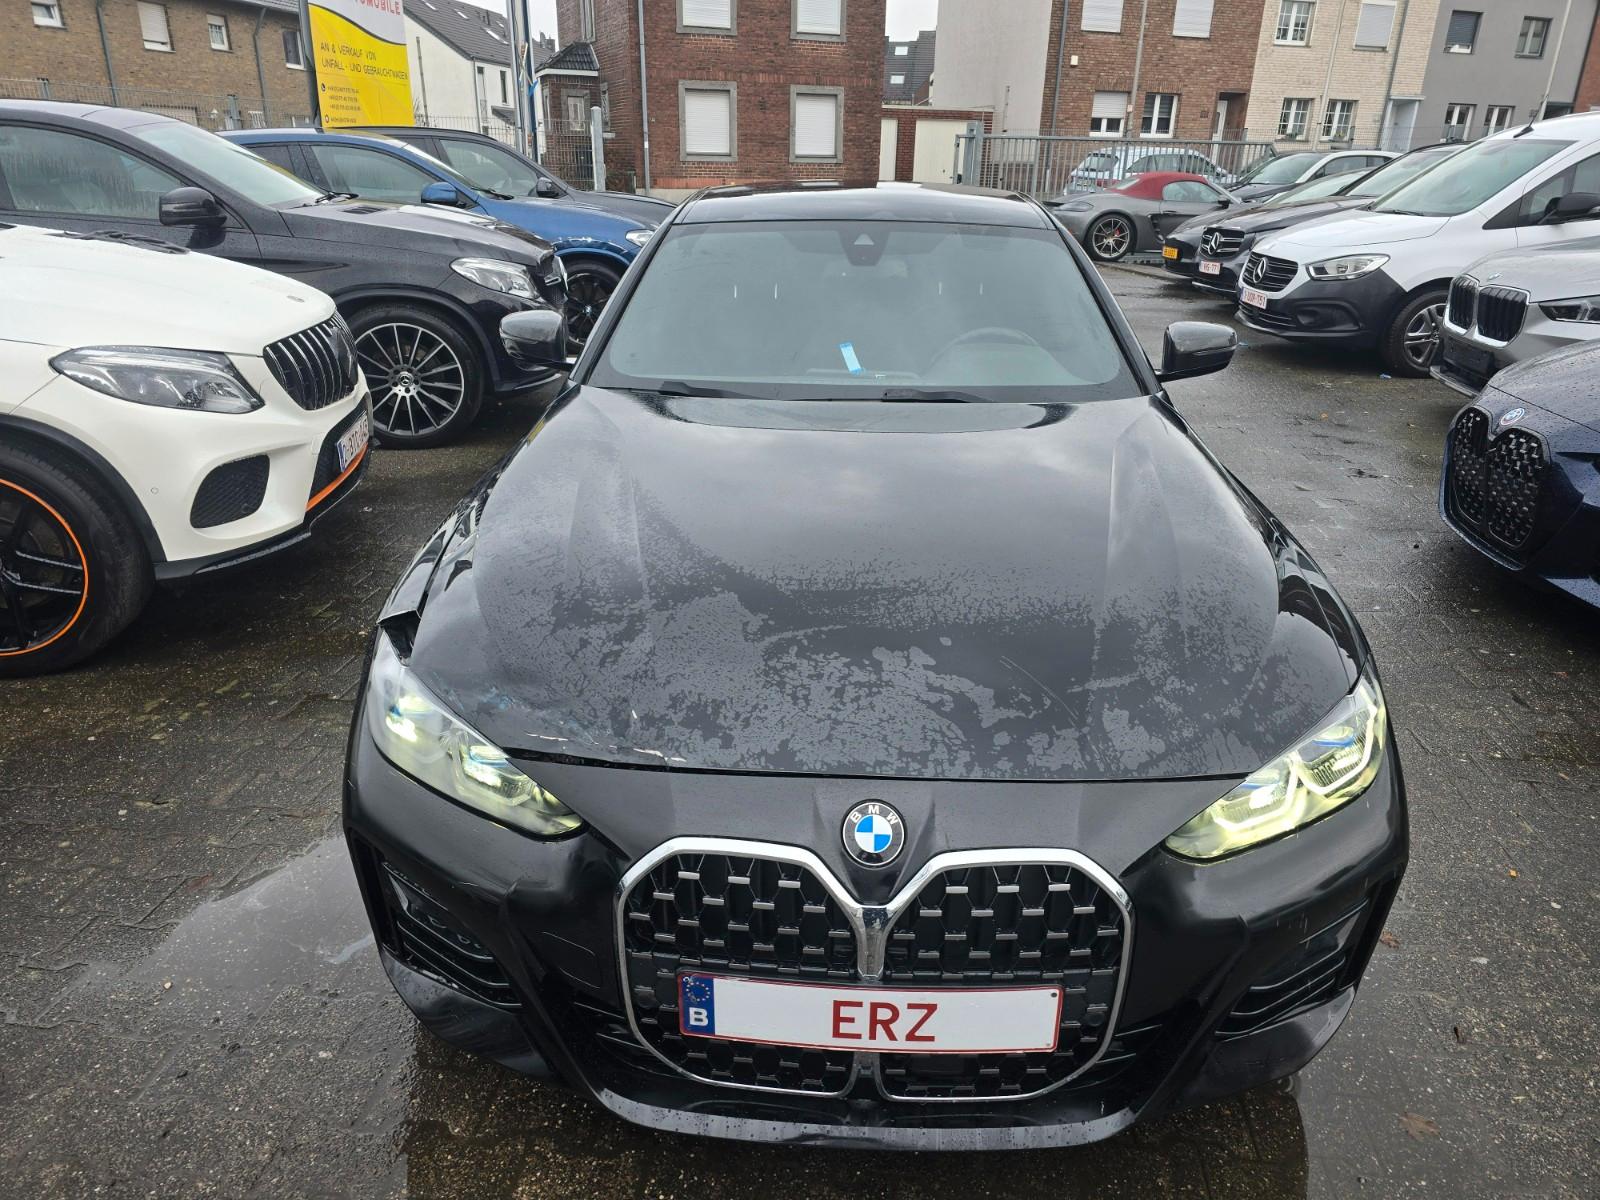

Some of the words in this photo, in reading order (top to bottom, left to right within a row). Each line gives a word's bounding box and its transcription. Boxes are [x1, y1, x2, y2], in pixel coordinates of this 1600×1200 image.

[338, 45, 362, 58] VERKAUF
[322, 57, 344, 71] UNFALL
[350, 63, 362, 73] UND
[364, 64, 408, 80] GEBRAUCHTWAGEN
[849, 804, 899, 825] BMW
[689, 1006, 710, 1027] B
[831, 1000, 938, 1042] ERZ
